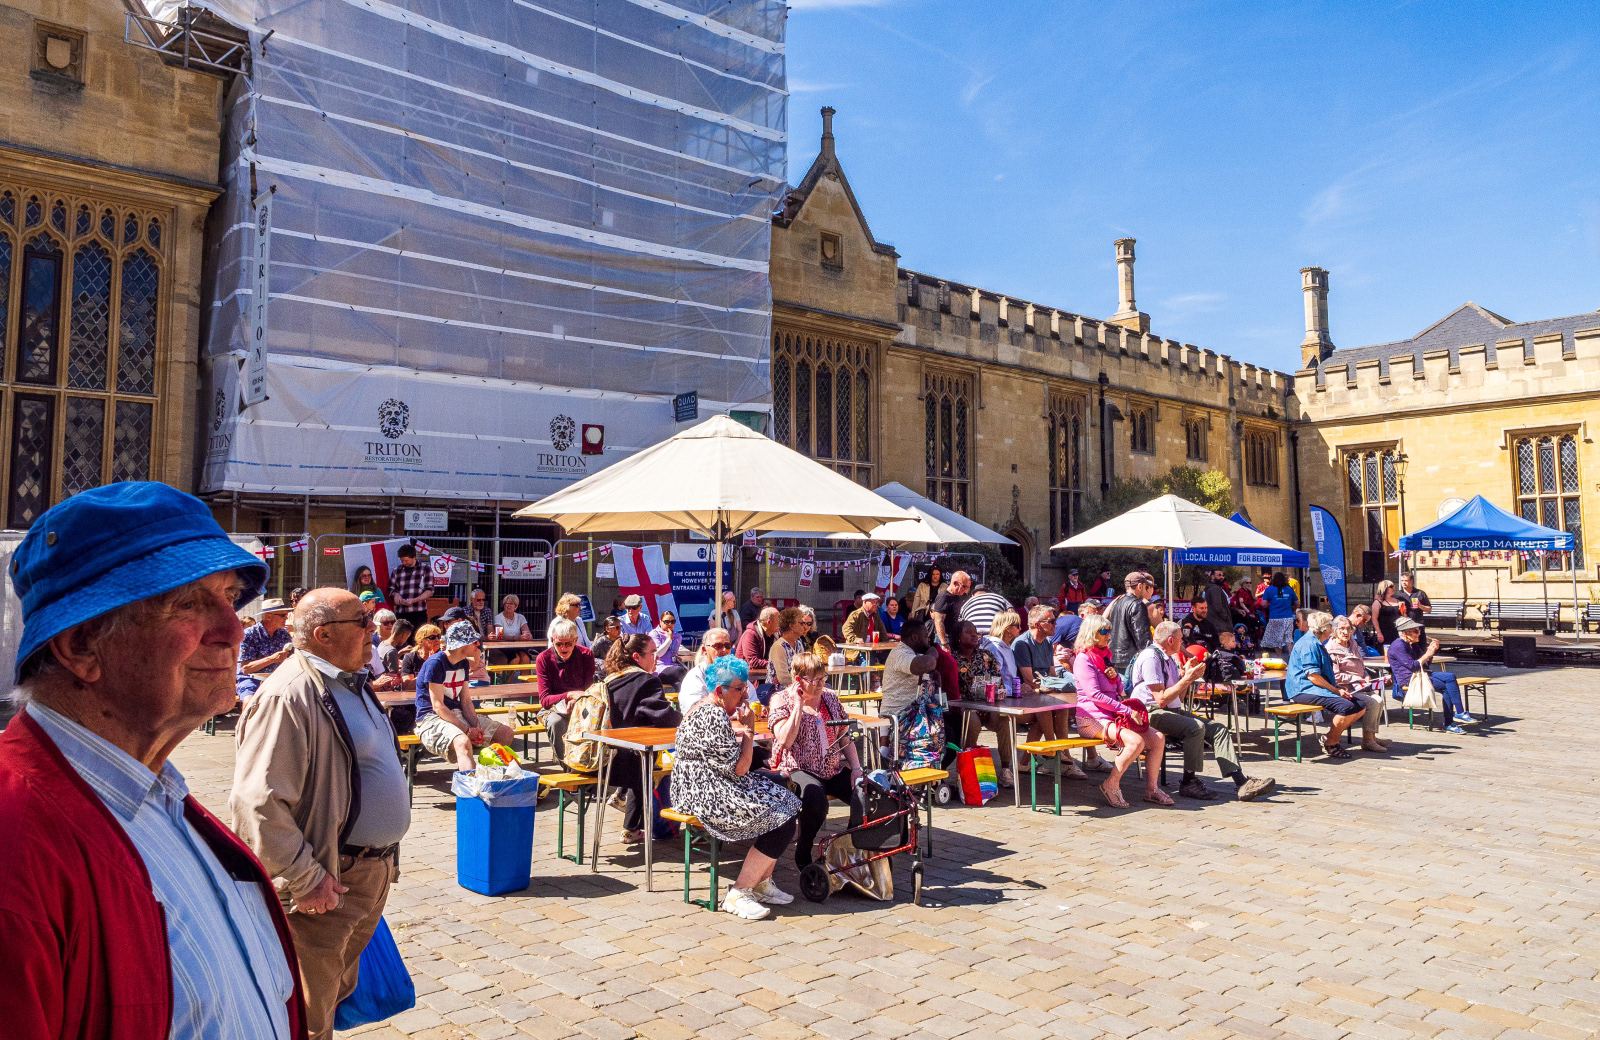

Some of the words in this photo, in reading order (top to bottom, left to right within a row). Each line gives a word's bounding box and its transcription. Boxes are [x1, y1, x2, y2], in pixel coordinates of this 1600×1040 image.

[255, 242, 266, 363] TRITON
[677, 395, 696, 406] QUAD
[364, 441, 422, 457] TRITON
[537, 453, 587, 468] TRITON
[1438, 540, 1490, 549] BEDFORD
[1493, 540, 1549, 549] MARKETS
[1185, 553, 1208, 561] LOCAL
[1209, 553, 1232, 562] RADIO
[1252, 555, 1281, 563] BEDFORD
